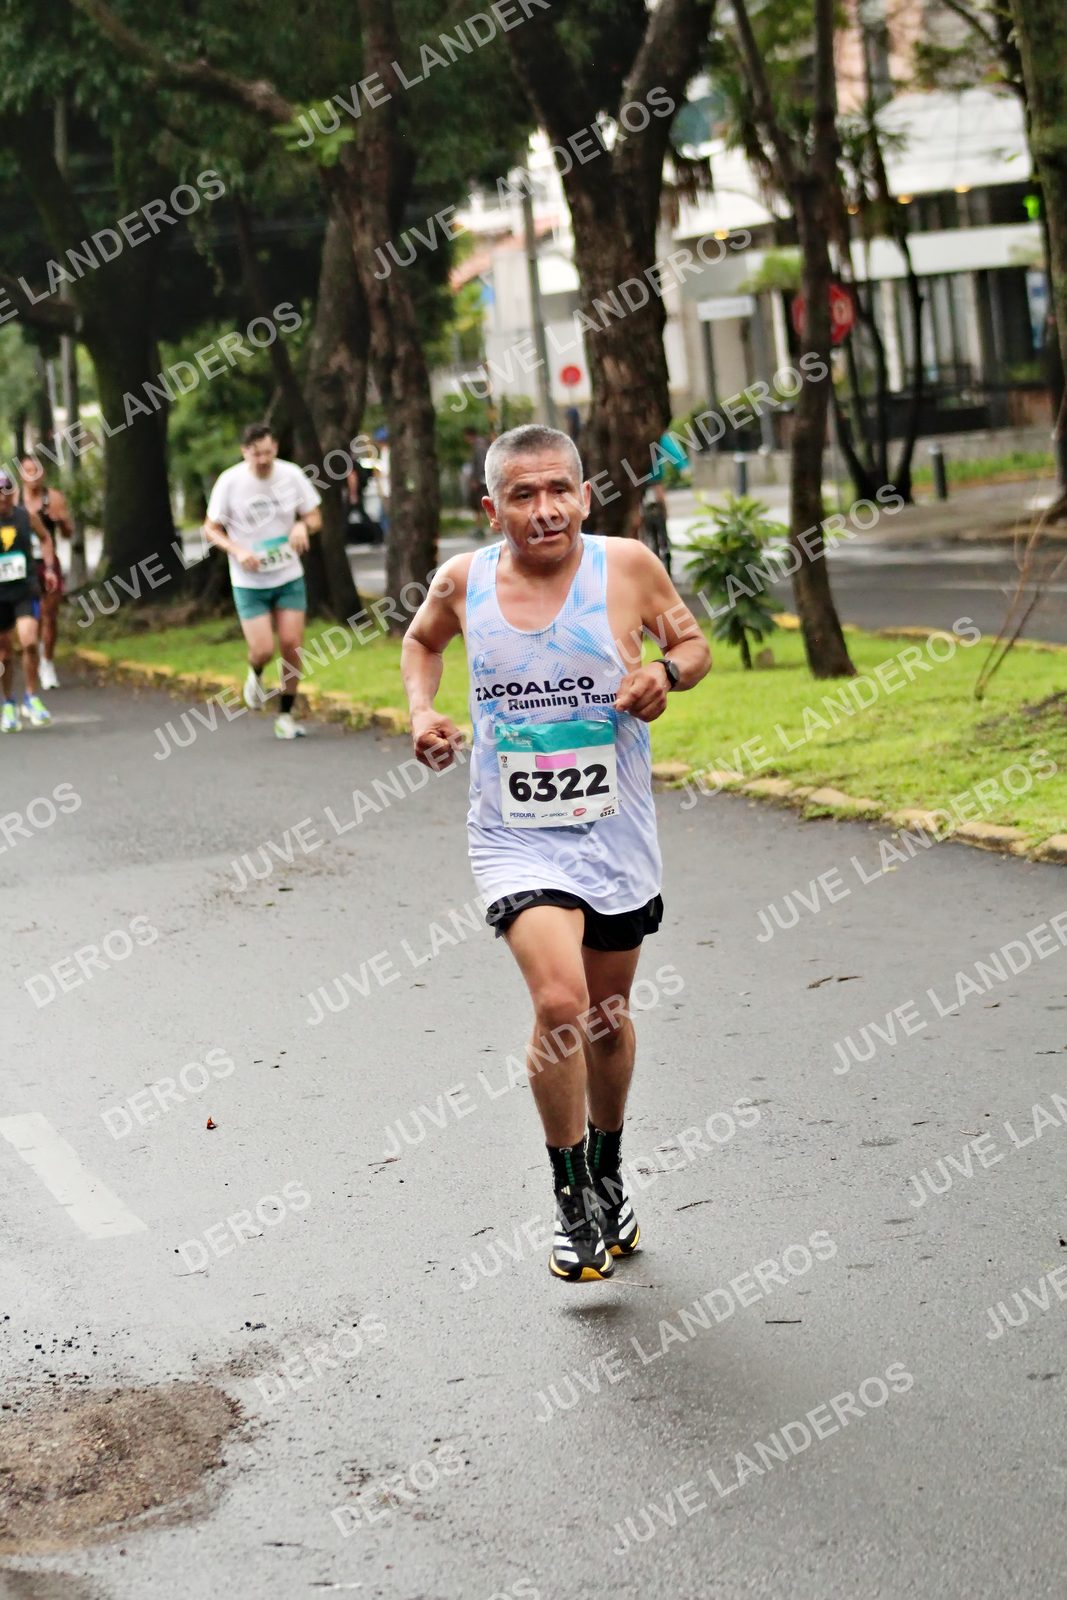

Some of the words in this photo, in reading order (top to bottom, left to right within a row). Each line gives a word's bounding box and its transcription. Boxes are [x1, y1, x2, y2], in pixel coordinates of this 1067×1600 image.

[475, 676, 595, 702] ZACOALCO
[508, 694, 579, 711] Running
[508, 763, 610, 802] 6322
[600, 808, 616, 818] 6322
